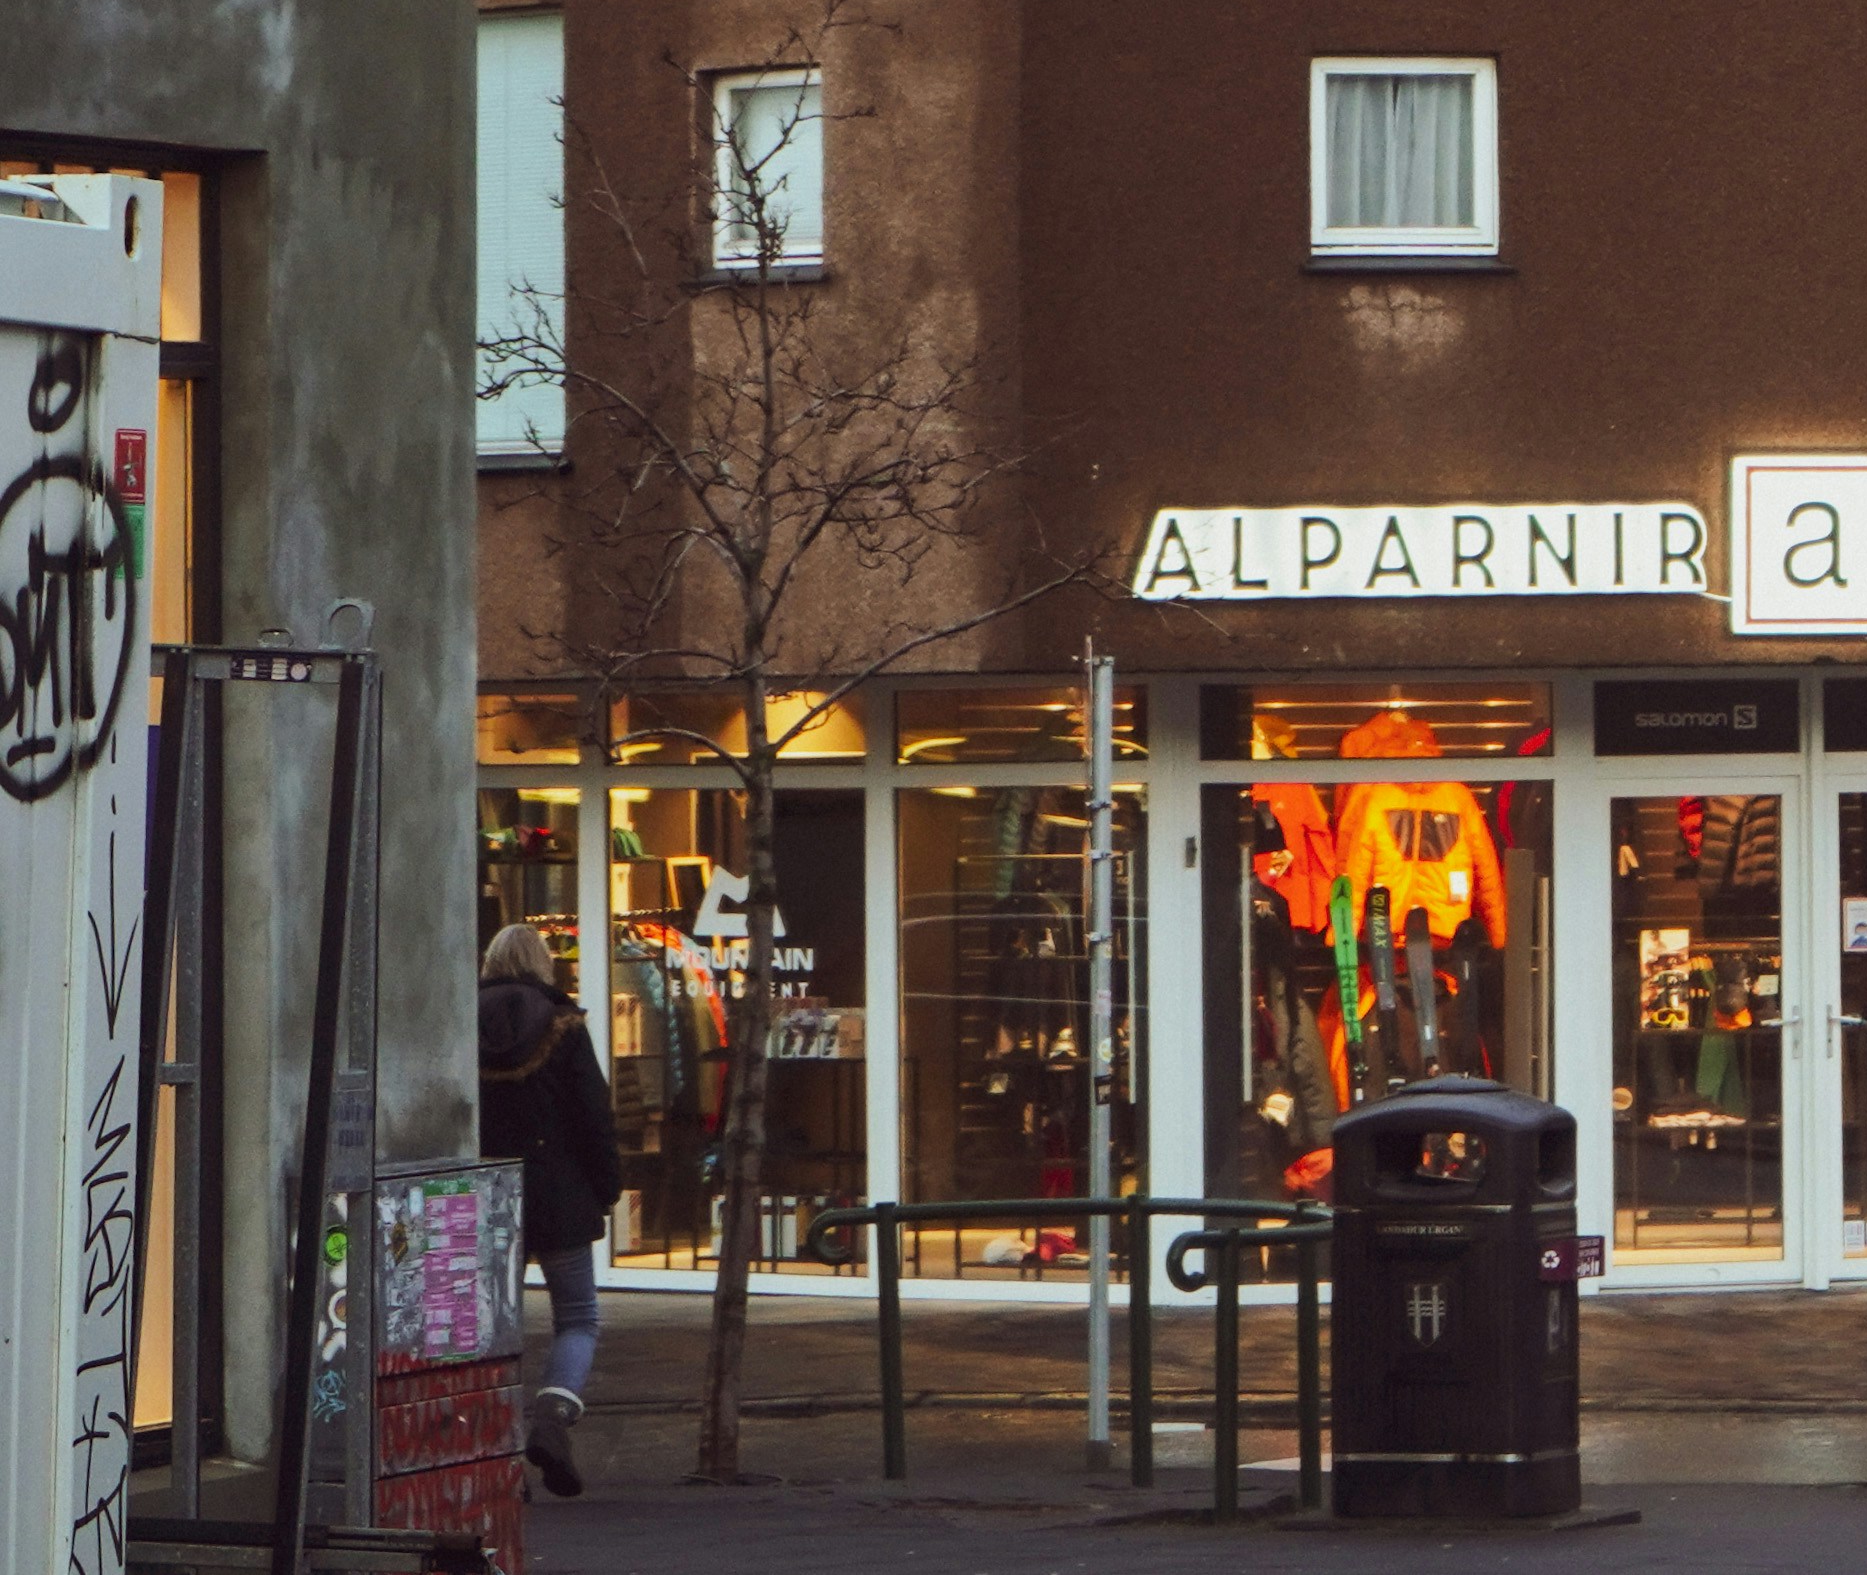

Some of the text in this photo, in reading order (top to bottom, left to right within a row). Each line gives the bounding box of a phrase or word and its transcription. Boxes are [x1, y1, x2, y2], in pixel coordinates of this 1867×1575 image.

[1143, 512, 1703, 592] ALPARNIR
[1783, 501, 1848, 589] a
[1635, 711, 1728, 727] salomon
[665, 945, 814, 972] MOUNAIN
